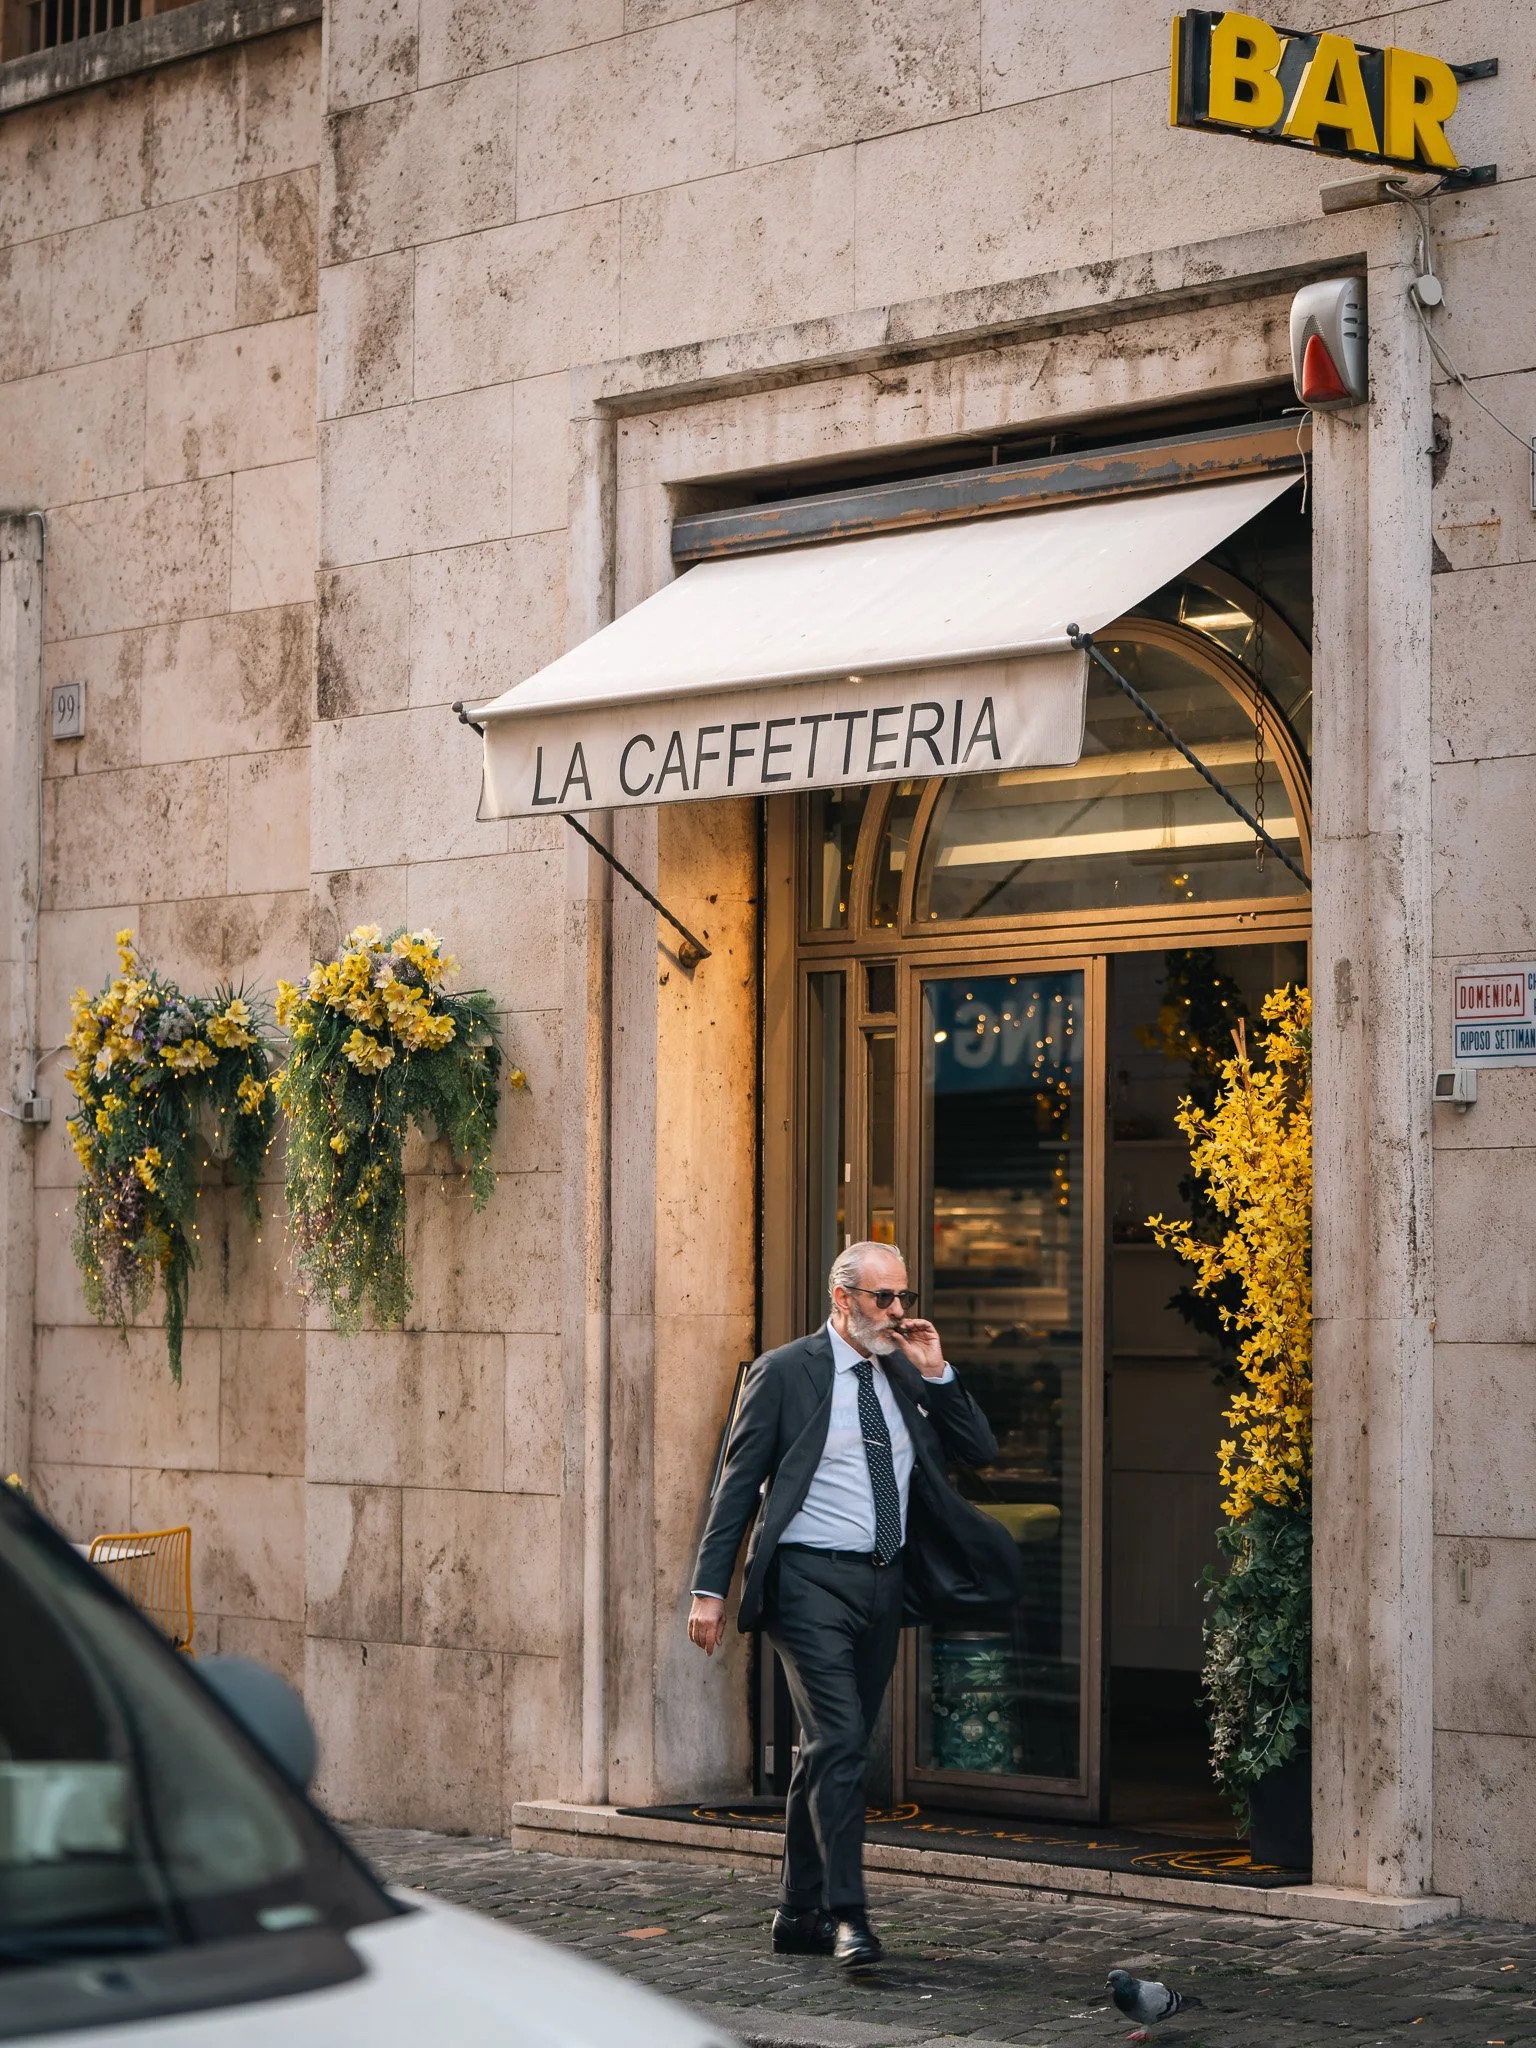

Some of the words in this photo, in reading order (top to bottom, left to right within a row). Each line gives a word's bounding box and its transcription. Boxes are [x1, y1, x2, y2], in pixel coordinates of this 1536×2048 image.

[1204, 11, 1459, 168] BAR
[58, 695, 75, 724] 99
[532, 741, 593, 806] LA
[619, 696, 1001, 796] CAFFETTERIA
[1460, 983, 1521, 1009] DOMENICA
[1460, 1030, 1491, 1051] RIPOSO
[1495, 1028, 1536, 1050] SETTIMAN
